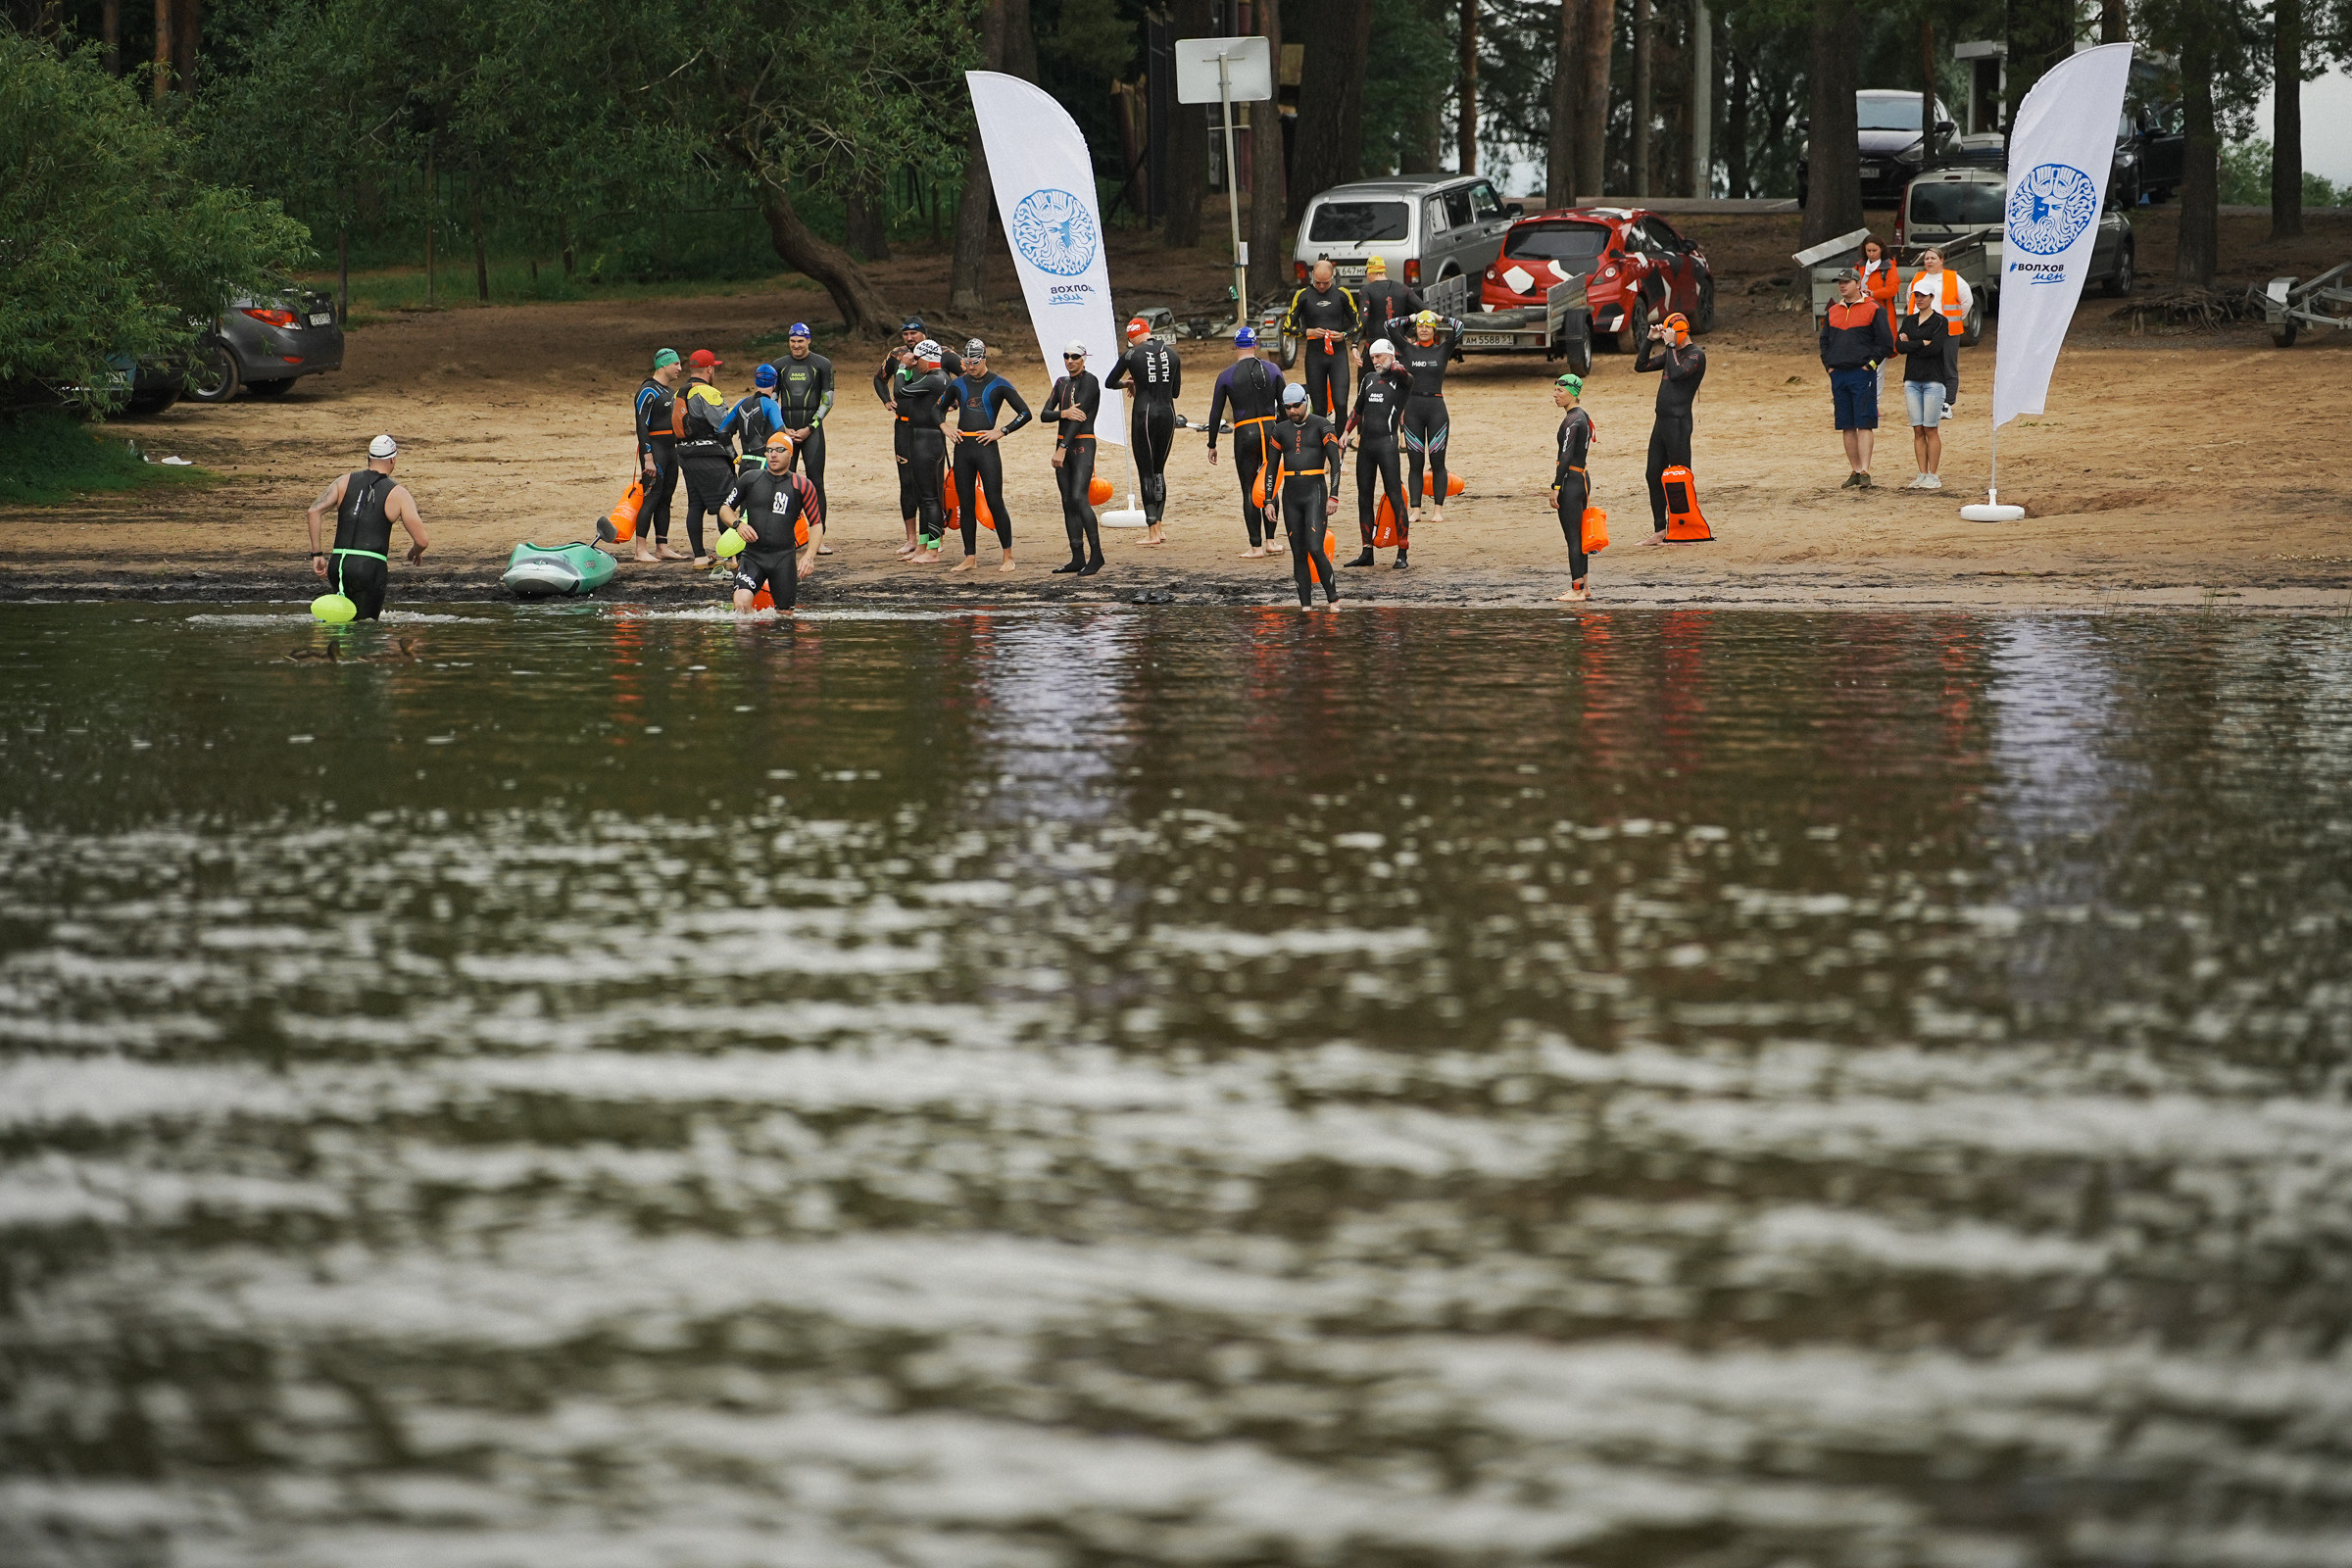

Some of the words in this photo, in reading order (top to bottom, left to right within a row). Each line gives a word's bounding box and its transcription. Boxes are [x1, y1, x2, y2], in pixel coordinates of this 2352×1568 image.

[1478, 335, 1500, 344] 5588
[1146, 351, 1156, 383] HUUB
[1159, 351, 1170, 382] HUUB
